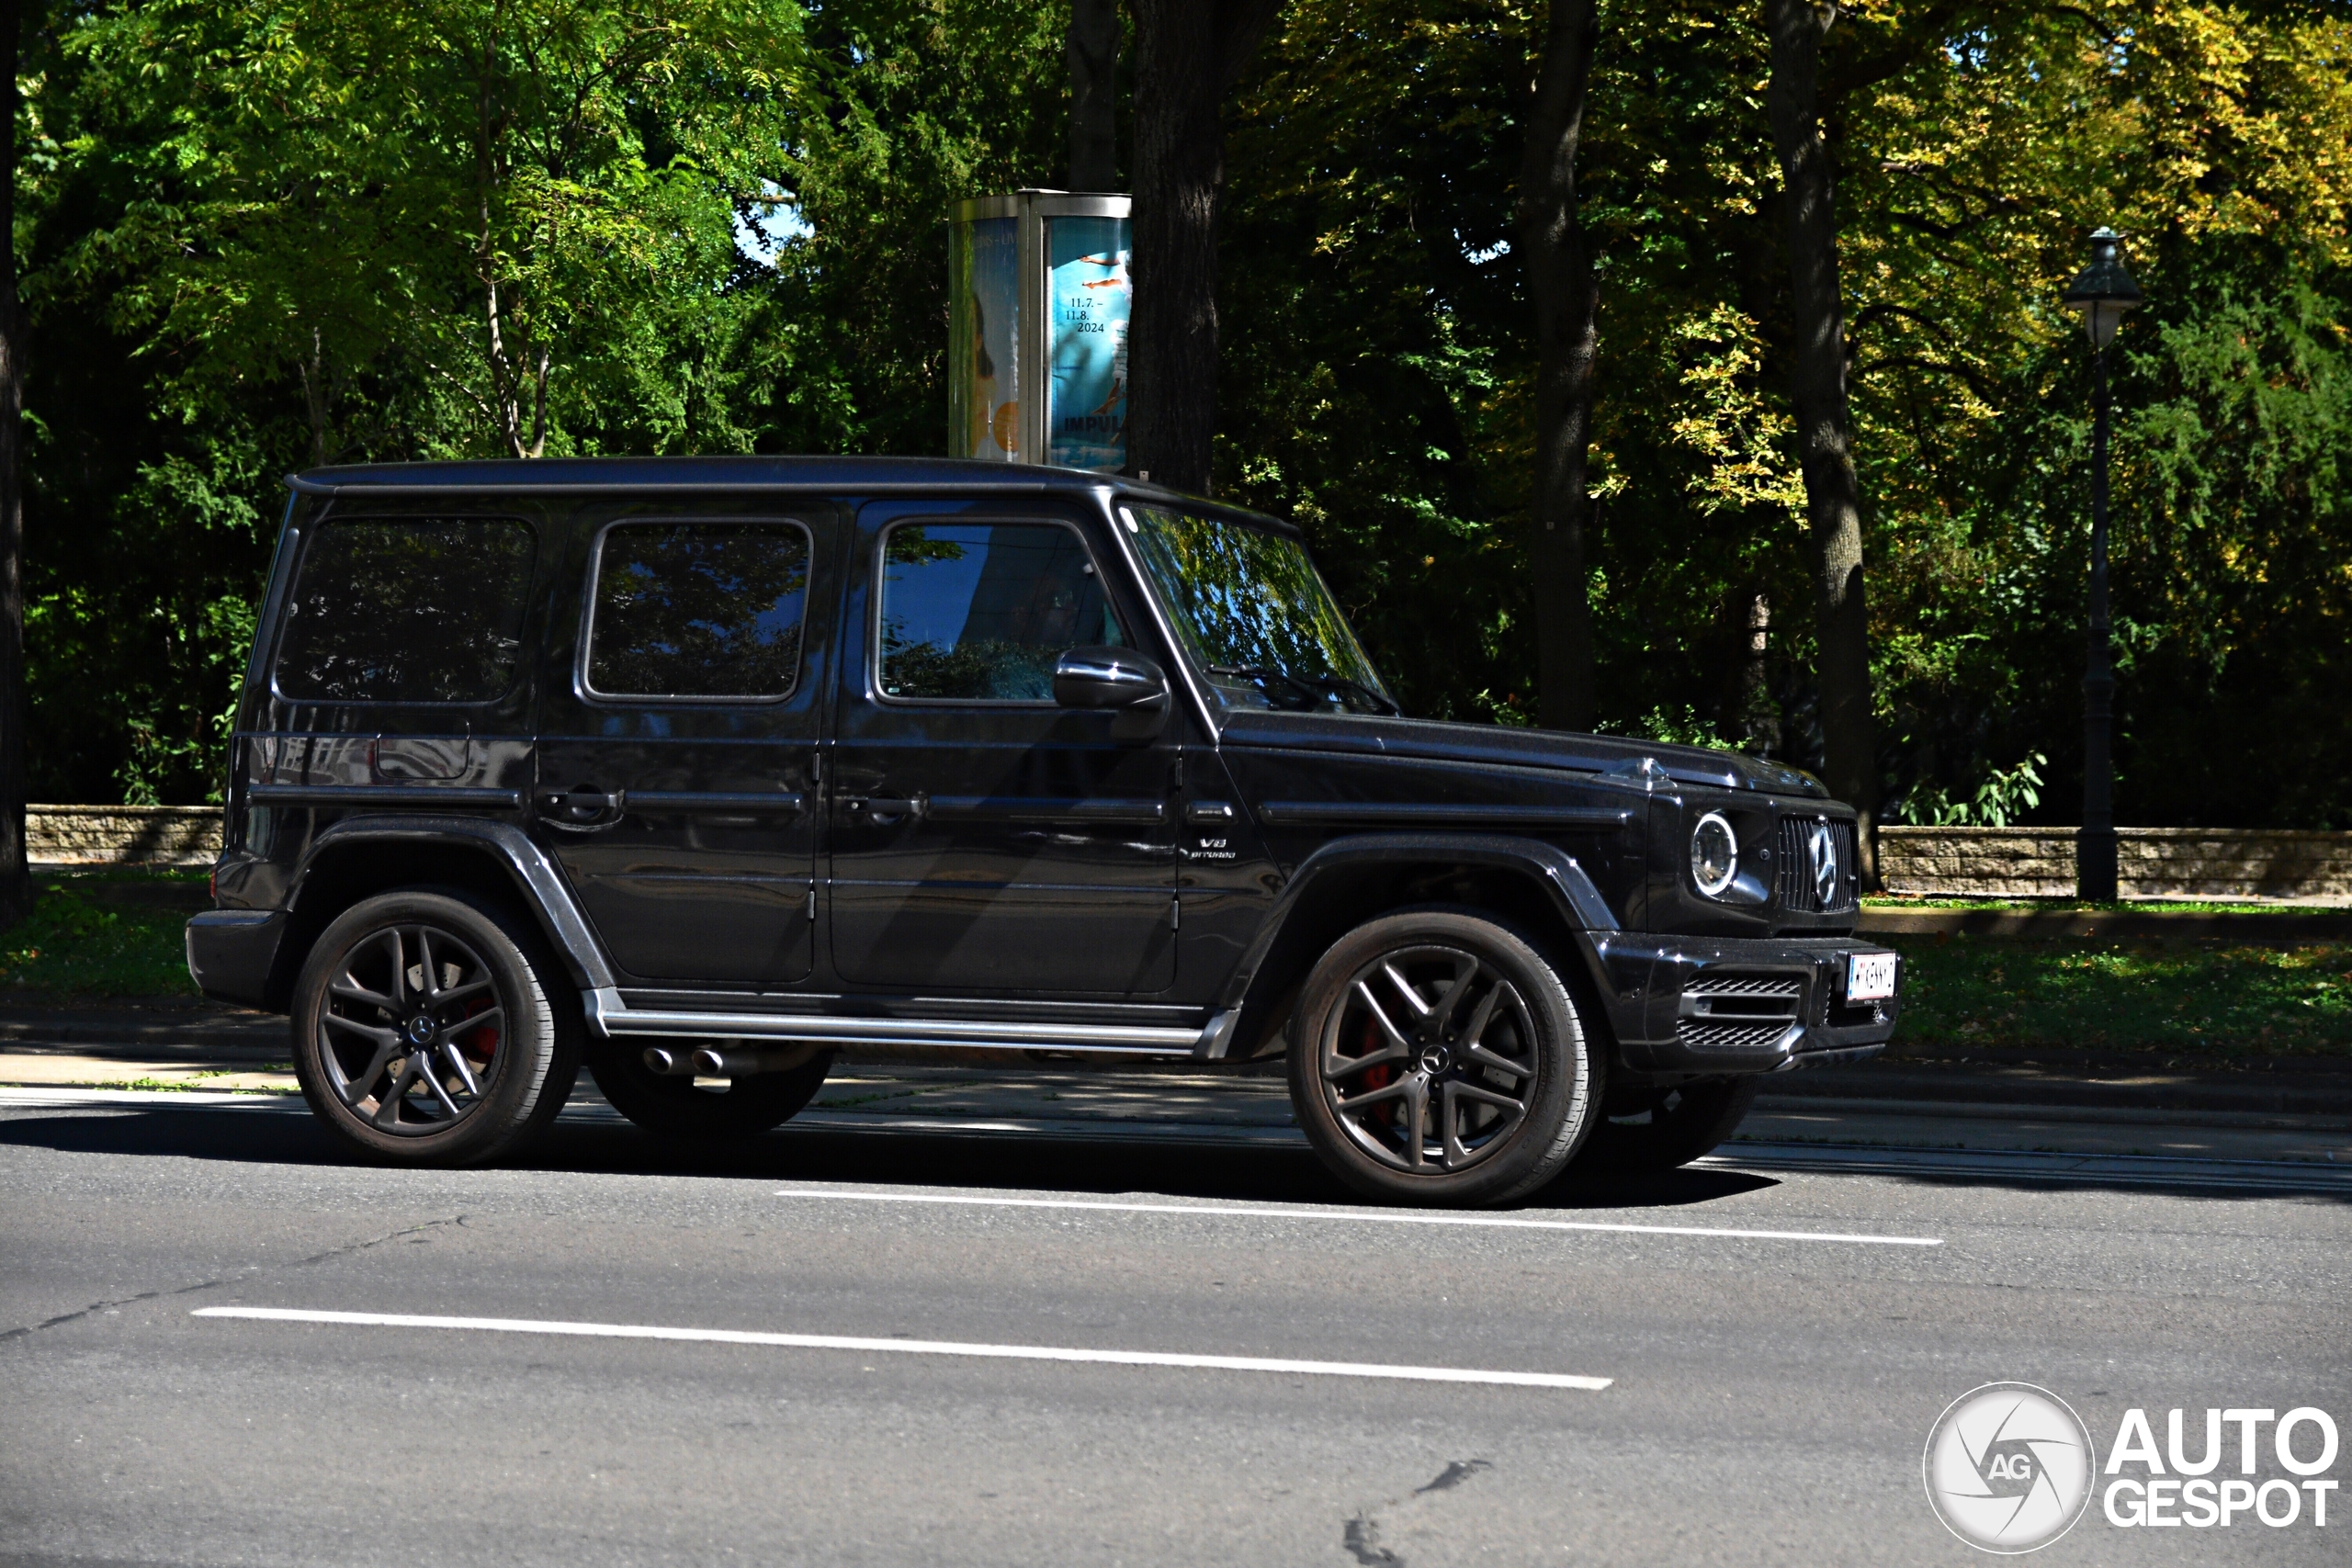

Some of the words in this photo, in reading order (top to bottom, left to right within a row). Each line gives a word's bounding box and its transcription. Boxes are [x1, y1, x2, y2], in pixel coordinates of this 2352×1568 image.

[1071, 298, 1094, 308] 11.7.
[1067, 310, 1090, 321] 11.8.
[1077, 322, 1104, 333] 2024
[1065, 416, 1128, 433] IMPUL
